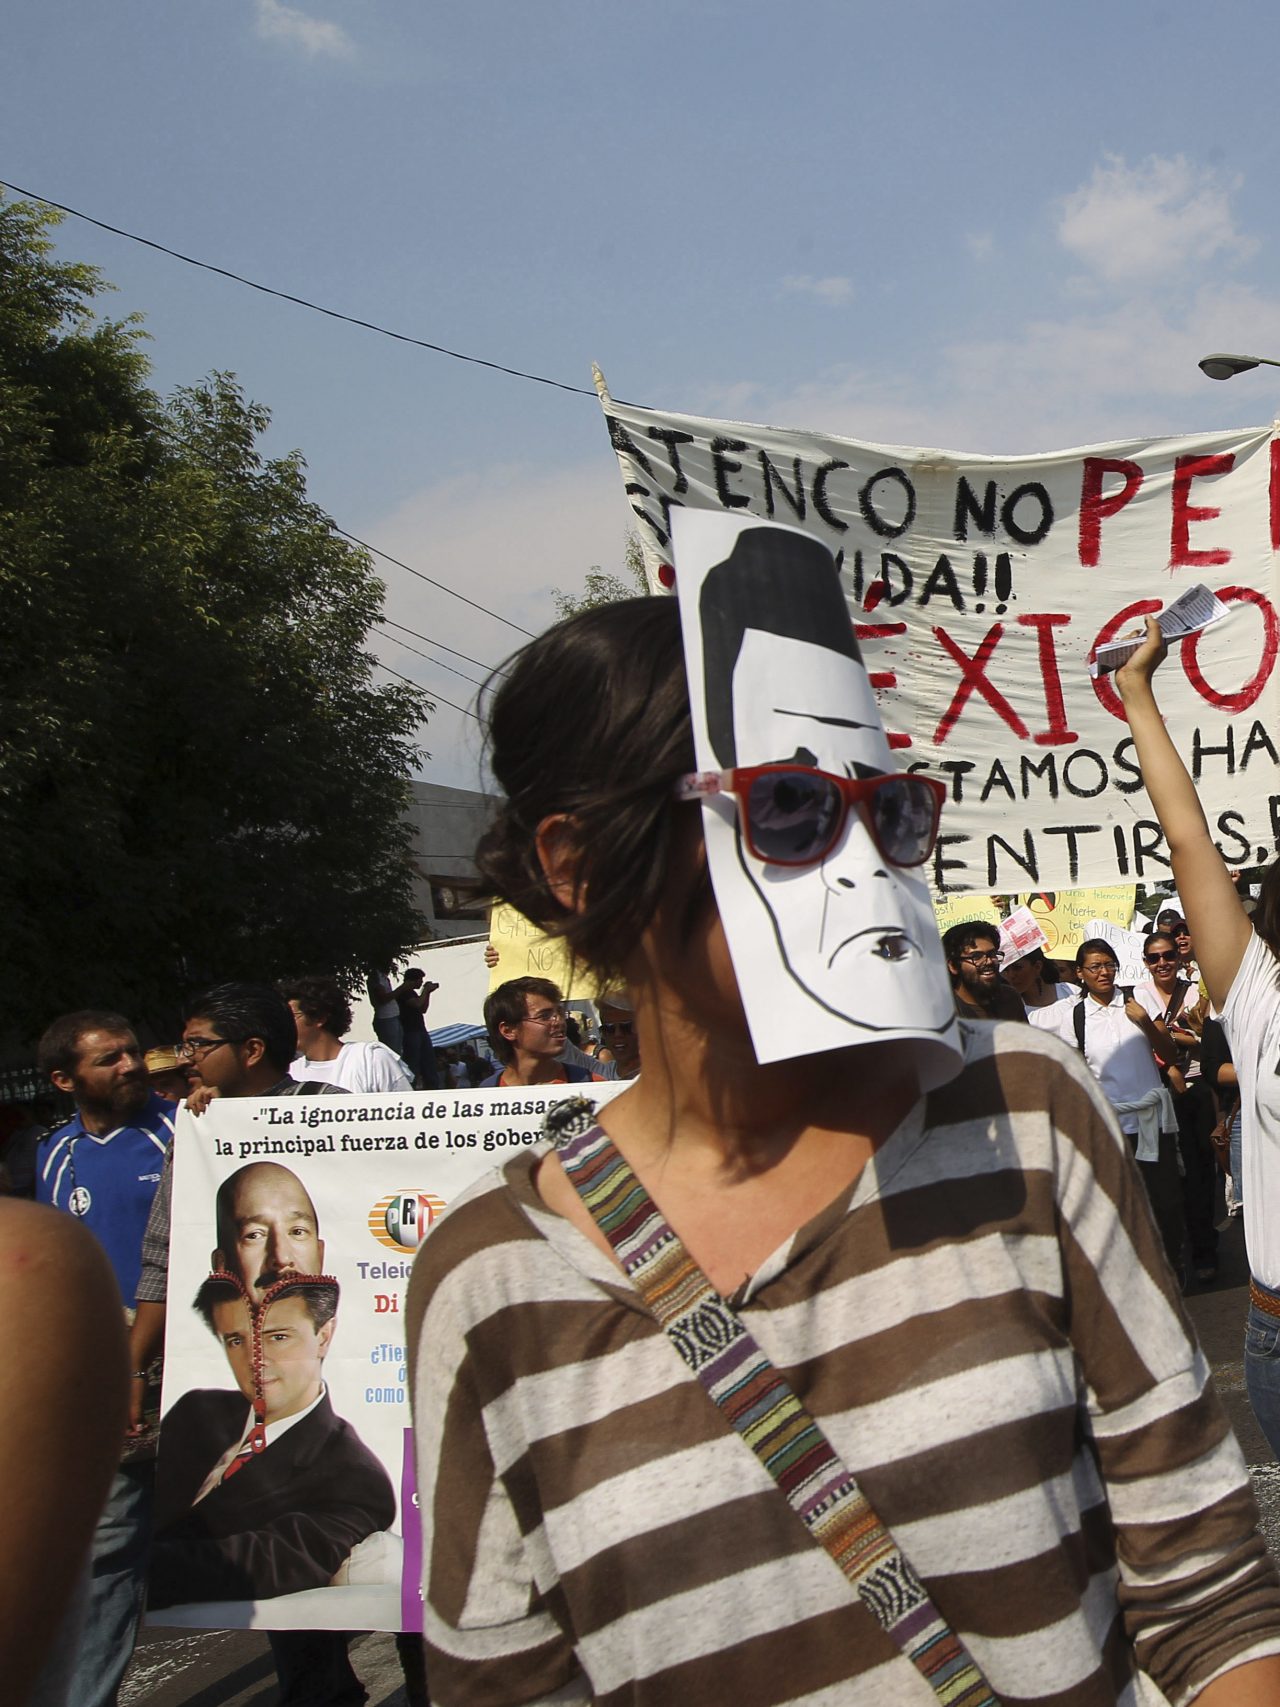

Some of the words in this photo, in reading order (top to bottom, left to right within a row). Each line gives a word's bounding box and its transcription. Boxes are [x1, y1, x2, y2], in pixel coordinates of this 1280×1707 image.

[955, 475, 1055, 545] NO
[835, 547, 1015, 615] IDA!!
[934, 808, 1268, 895] ENTIRS,
[527, 947, 554, 972] NO
[300, 1102, 416, 1128] ignorancia
[421, 1101, 448, 1119] de
[453, 1099, 485, 1118] las
[215, 1138, 235, 1156] la
[239, 1136, 335, 1159] principal
[340, 1134, 408, 1152] fuerza
[414, 1132, 440, 1150] de
[445, 1130, 477, 1149] los
[387, 1198, 430, 1233] PRI
[365, 1387, 405, 1403] como
